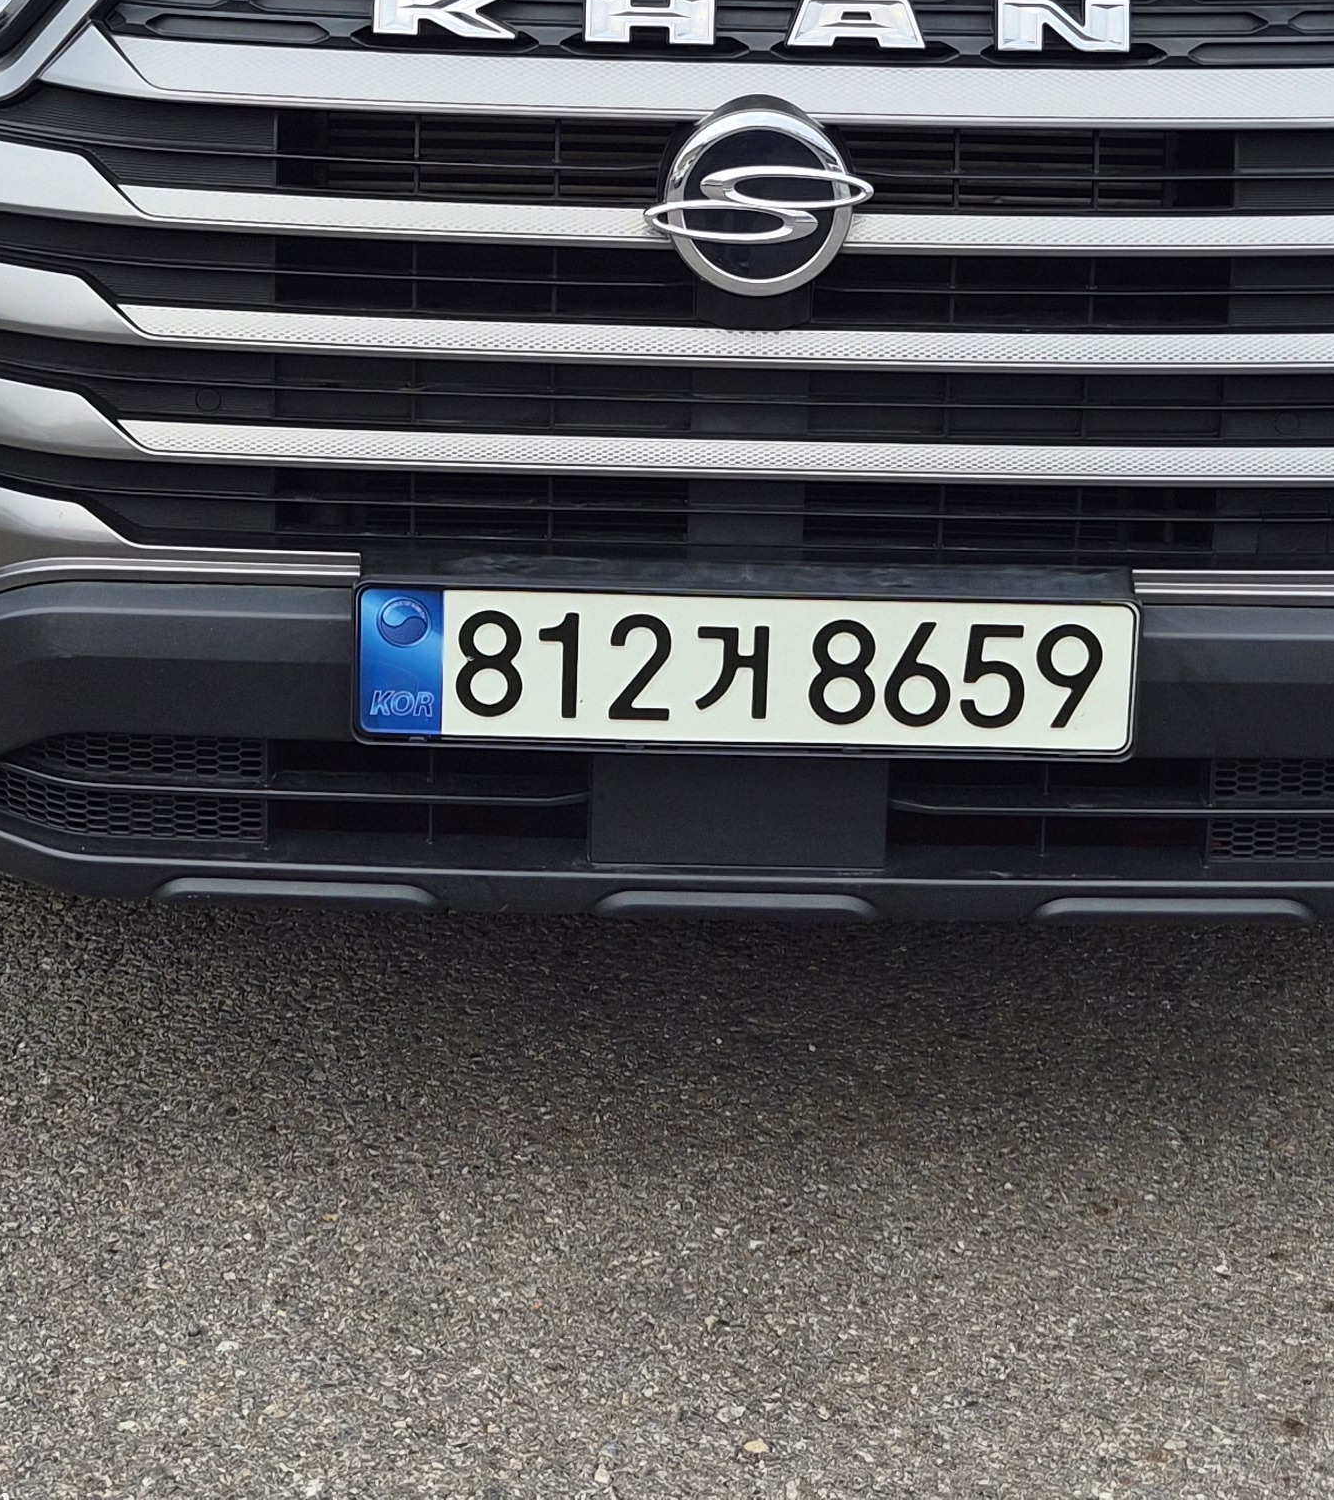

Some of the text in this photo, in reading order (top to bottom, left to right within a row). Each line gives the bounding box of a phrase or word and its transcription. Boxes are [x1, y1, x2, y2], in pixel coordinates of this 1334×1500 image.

[370, 690, 434, 717] KOR
[455, 609, 1104, 730] 812거 8659
